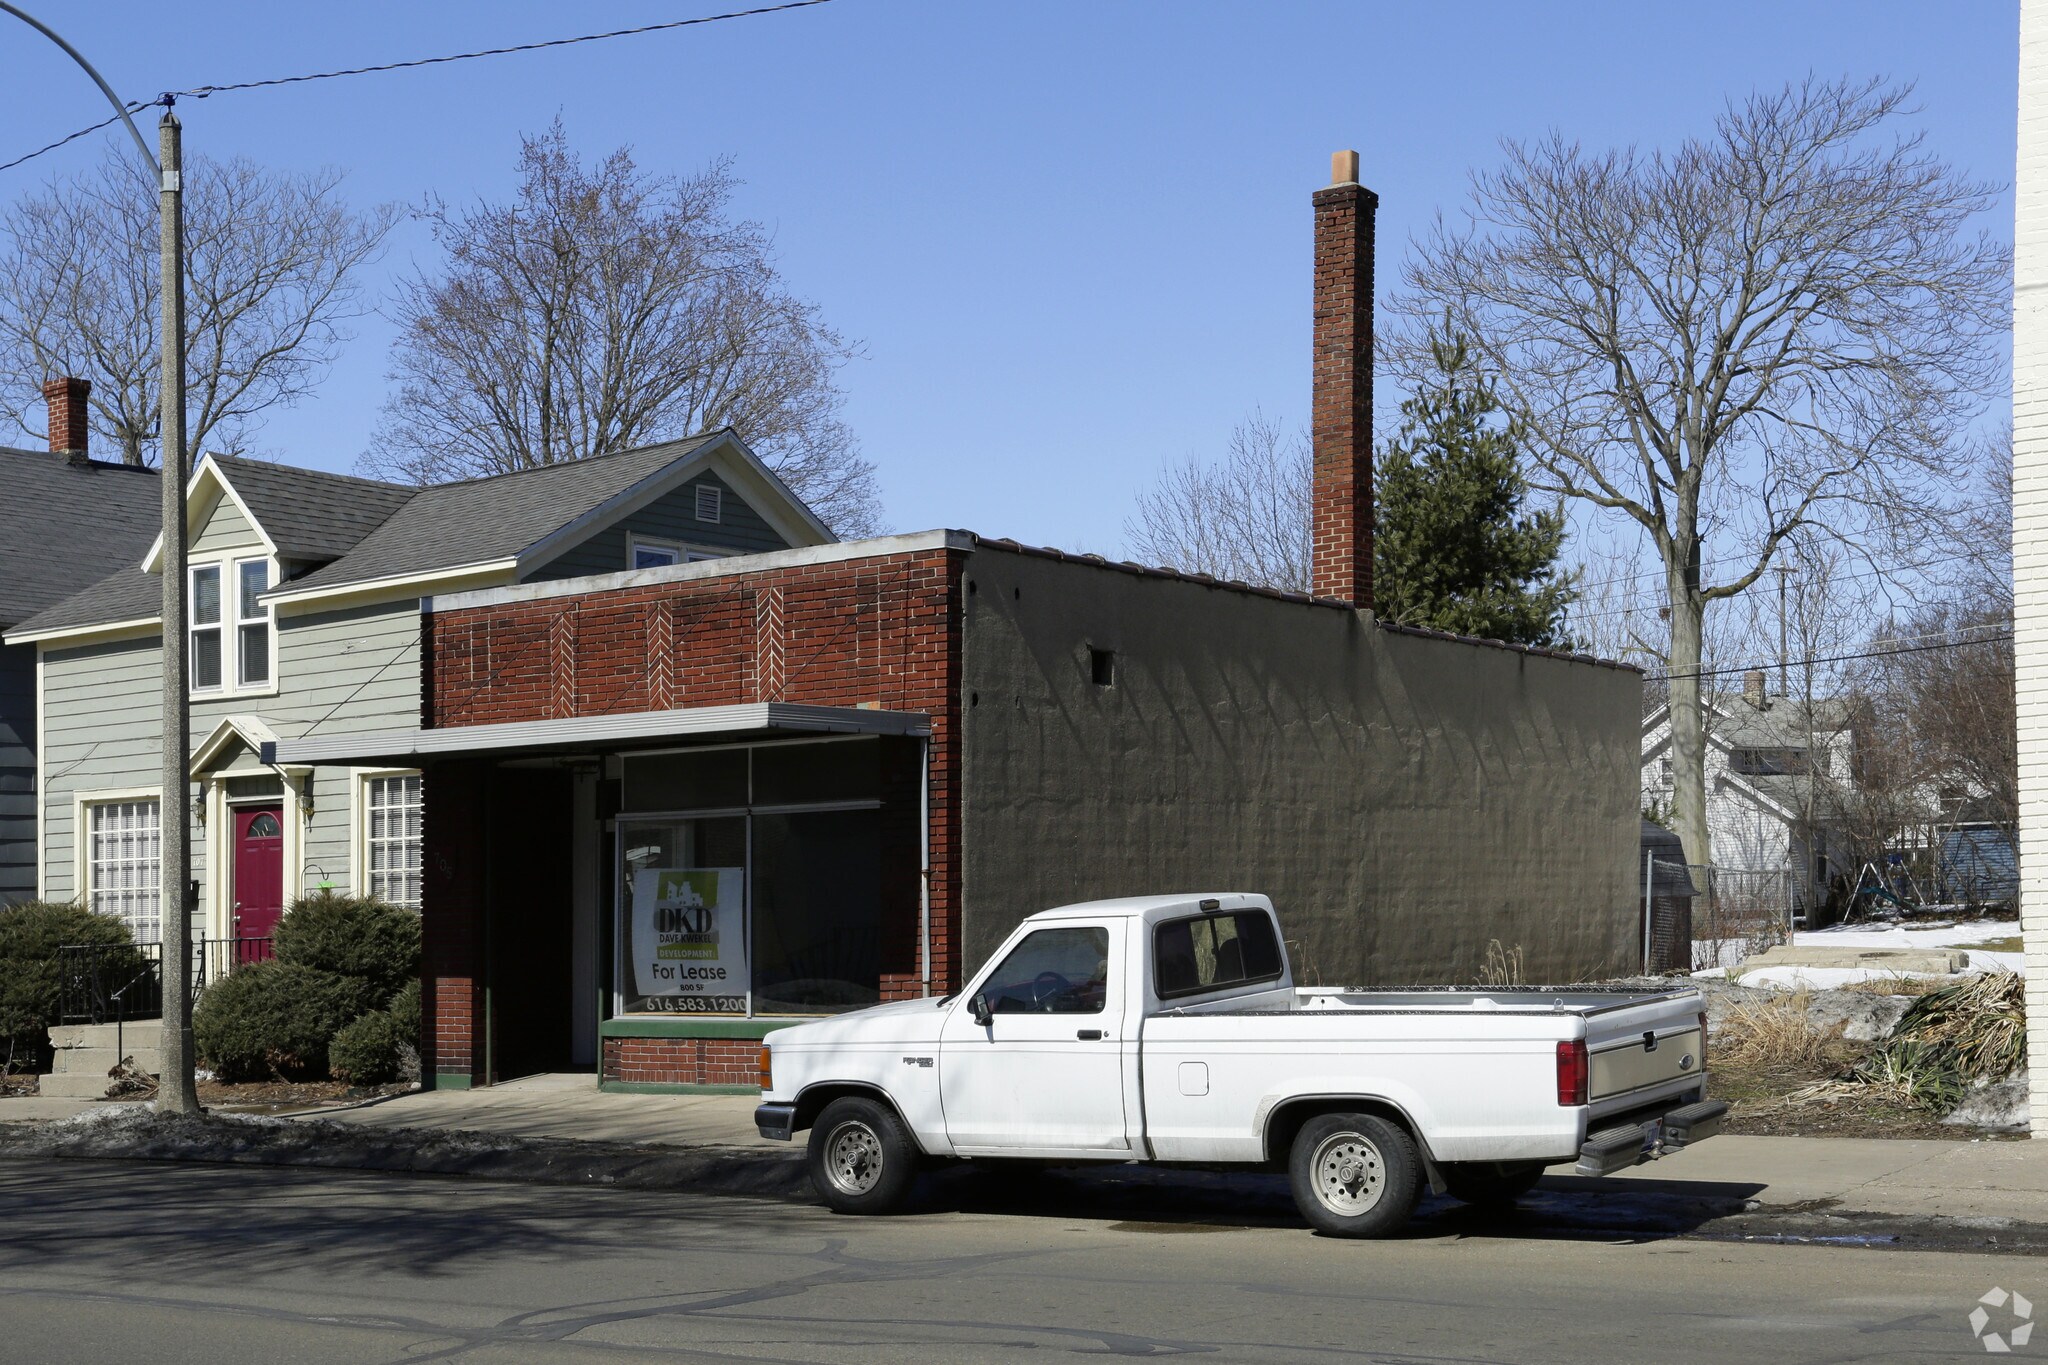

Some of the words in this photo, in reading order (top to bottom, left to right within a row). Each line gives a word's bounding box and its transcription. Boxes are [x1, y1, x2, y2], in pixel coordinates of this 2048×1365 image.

[659, 907, 713, 934] DKD
[660, 934, 679, 943] DAVE
[681, 934, 712, 943] KWEKEL
[660, 950, 713, 958] DEVELOPMENT
[652, 963, 675, 979] For
[680, 963, 727, 980] Lease
[646, 997, 747, 1011] 616.583.1200
